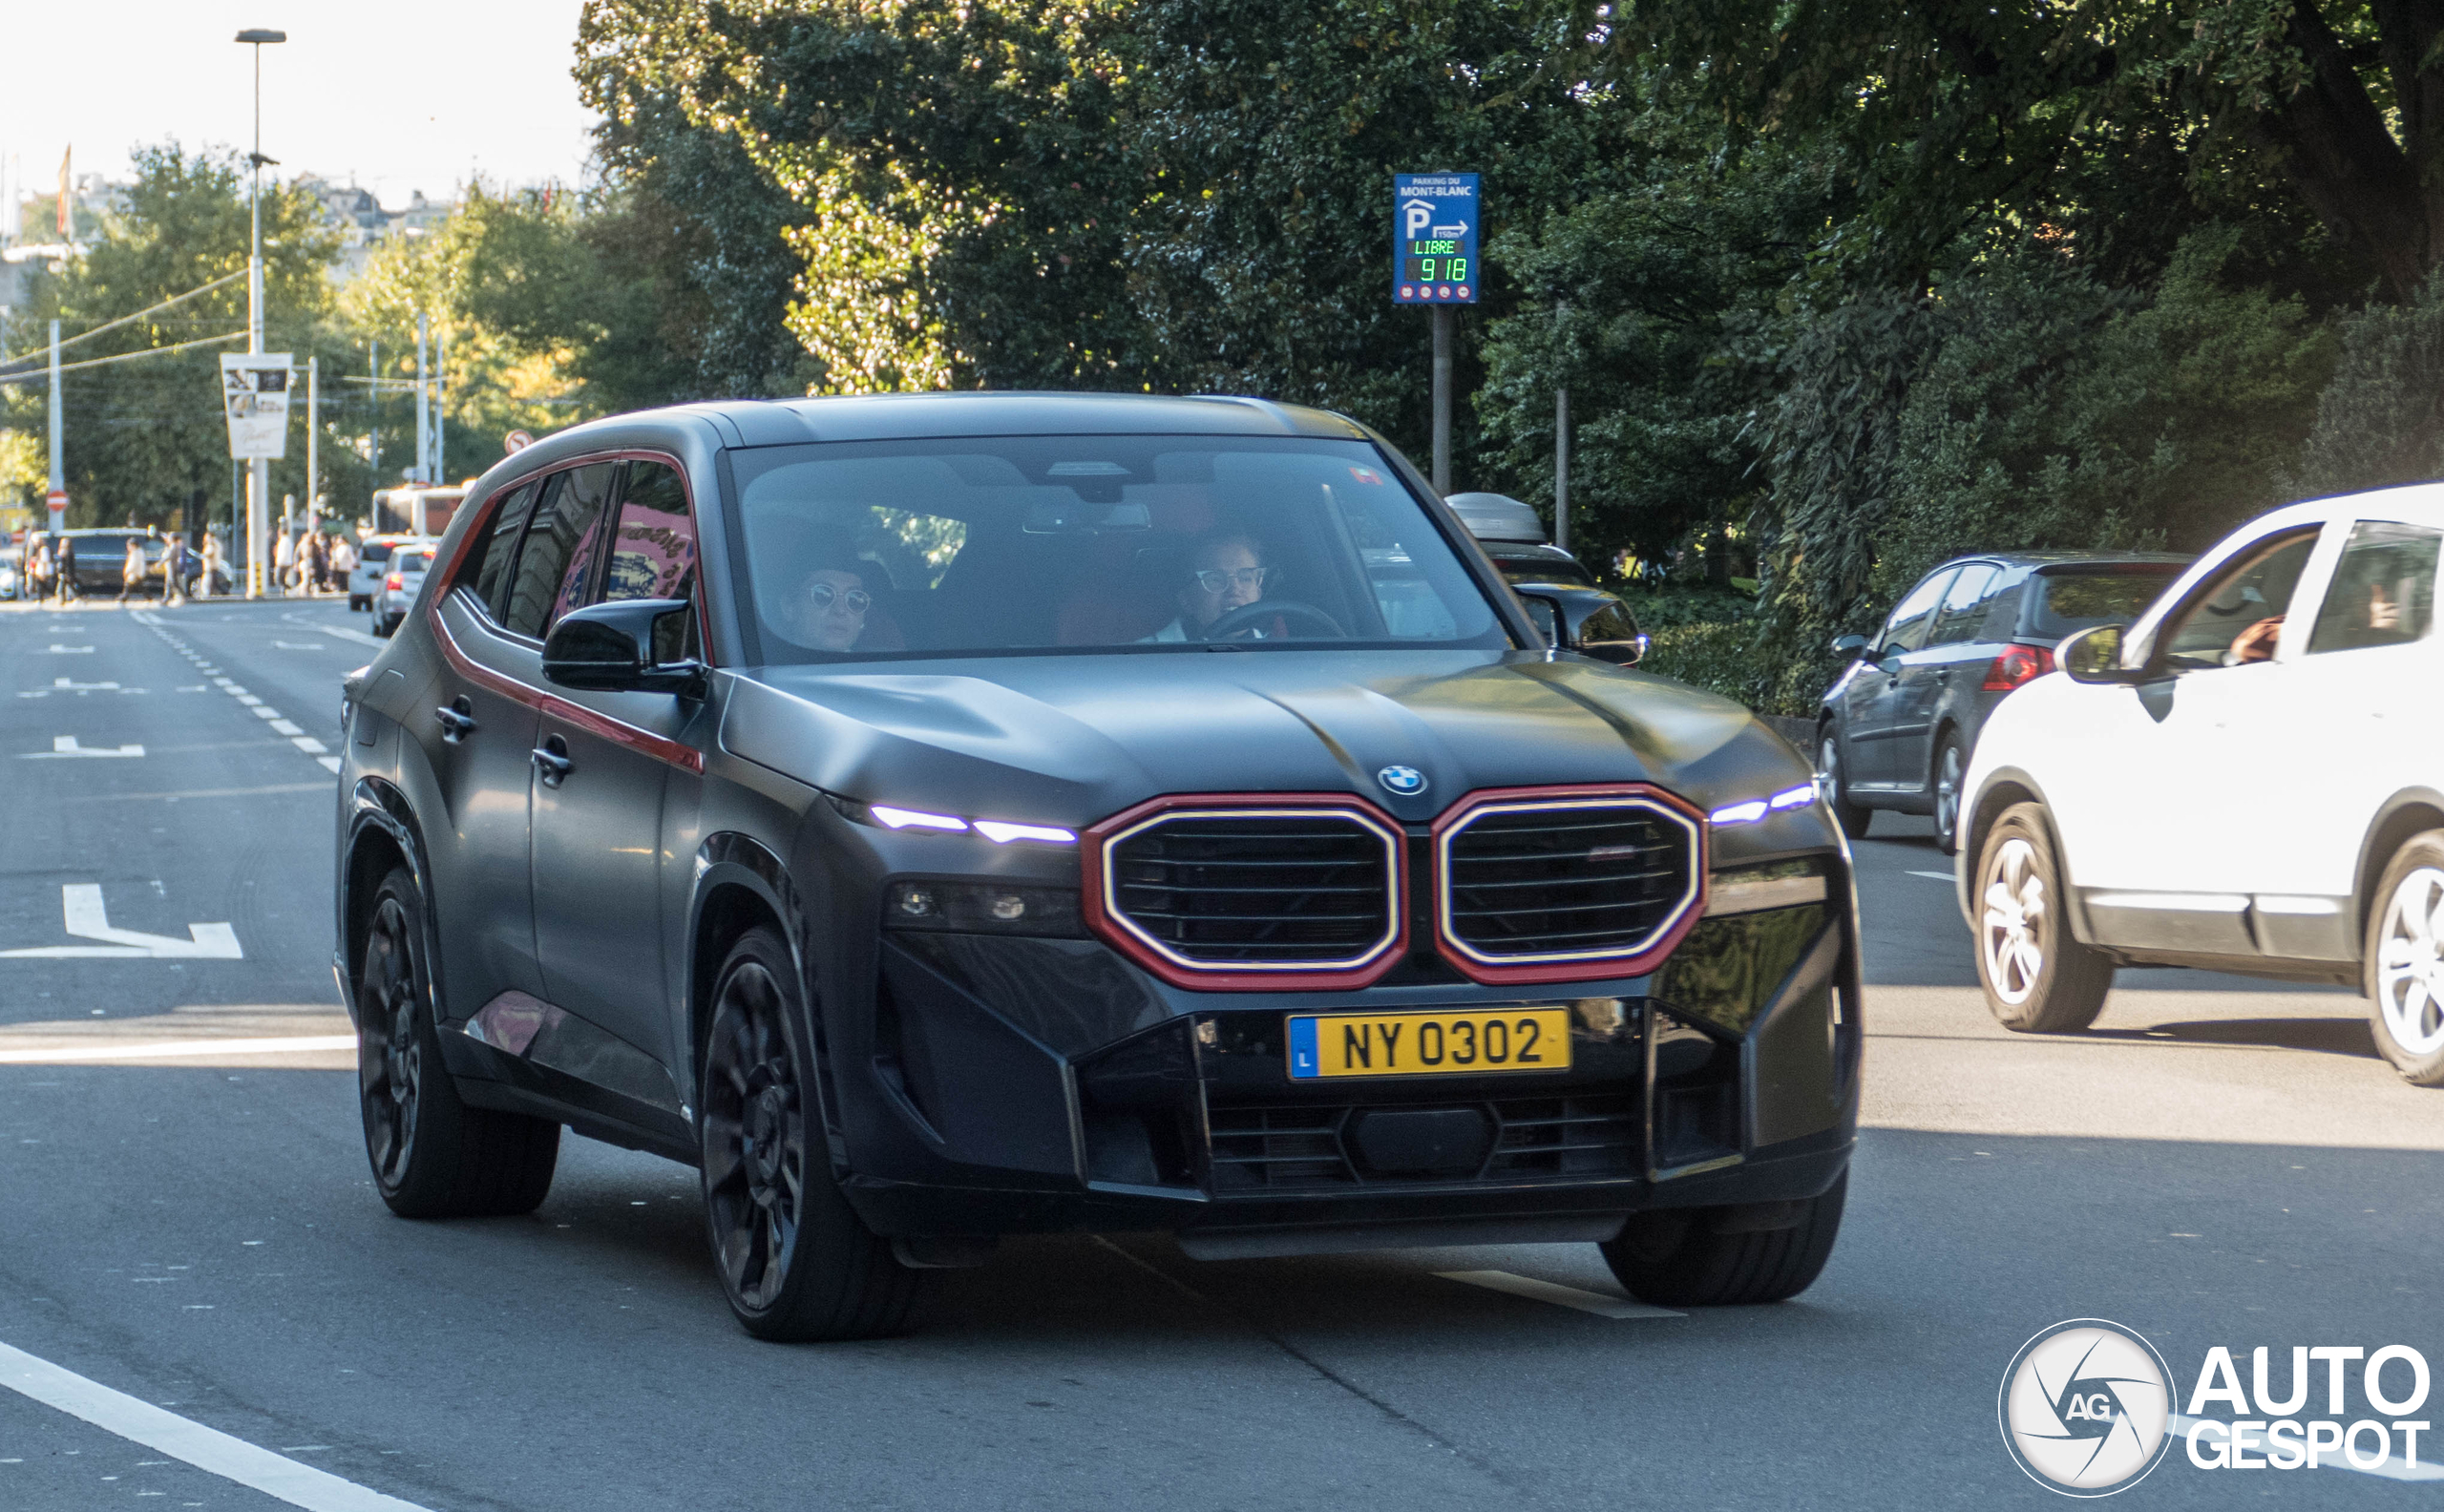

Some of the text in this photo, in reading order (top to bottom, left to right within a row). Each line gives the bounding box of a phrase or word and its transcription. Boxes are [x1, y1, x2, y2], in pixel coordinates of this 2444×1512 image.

[1401, 186, 1472, 197] MONT-BLANC
[1407, 208, 1431, 239] P
[1415, 240, 1455, 255] LIBRE
[1421, 258, 1467, 282] 918
[1343, 1018, 1542, 1068] NY 0302
[1298, 1052, 1311, 1068] L
